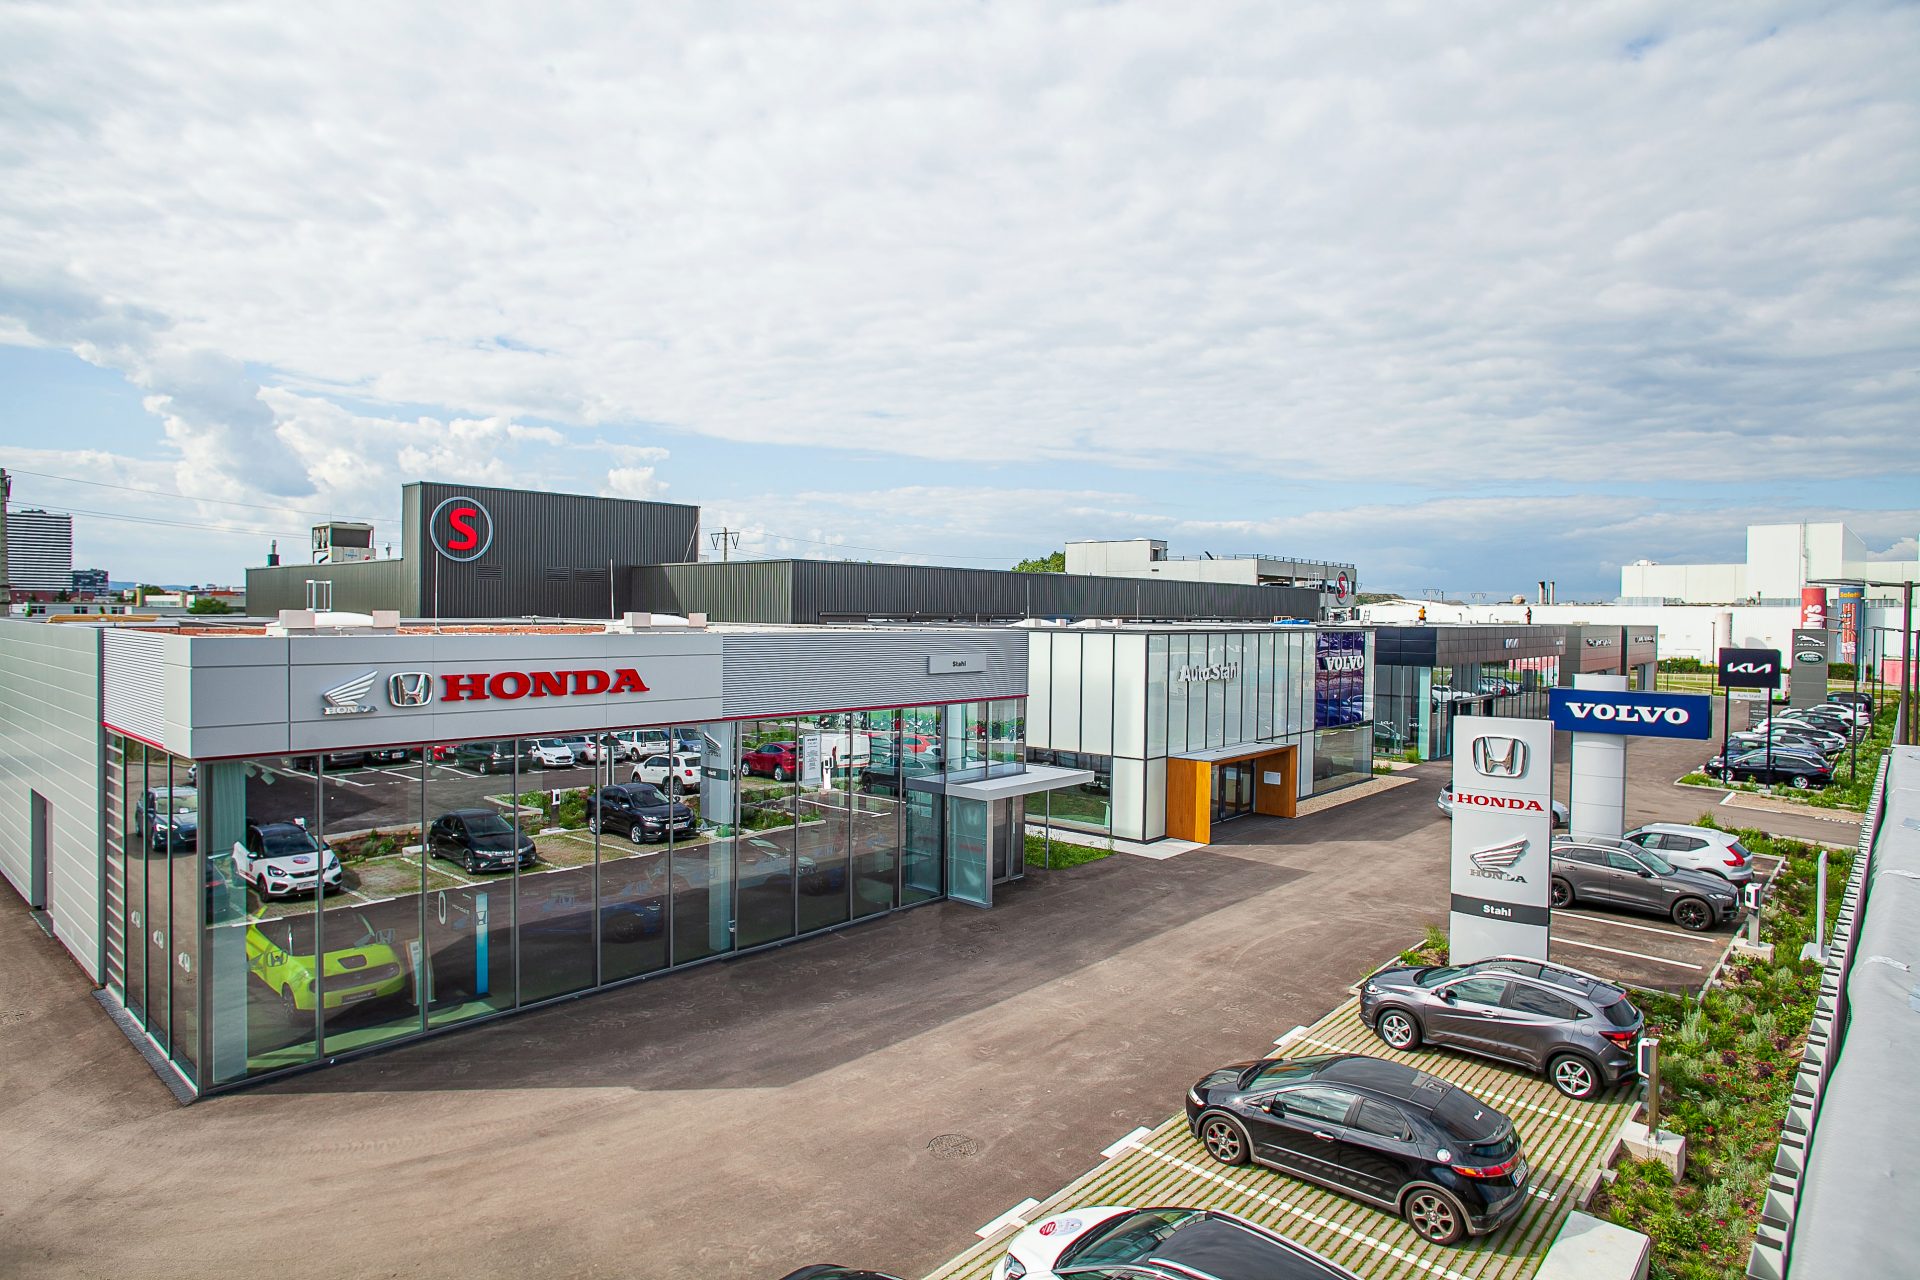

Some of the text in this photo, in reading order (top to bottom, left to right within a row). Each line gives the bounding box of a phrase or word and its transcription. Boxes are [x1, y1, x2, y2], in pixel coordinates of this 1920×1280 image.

[447, 507, 478, 551] S
[952, 660, 967, 668] Stahl
[1325, 655, 1365, 671] VOLVO
[441, 668, 650, 702] HONDA
[324, 705, 378, 715] HONDA
[1565, 701, 1690, 725] VOLVO
[1457, 792, 1544, 811] HONDA
[1469, 868, 1528, 884] HONDA
[1482, 904, 1512, 917] Stahl
